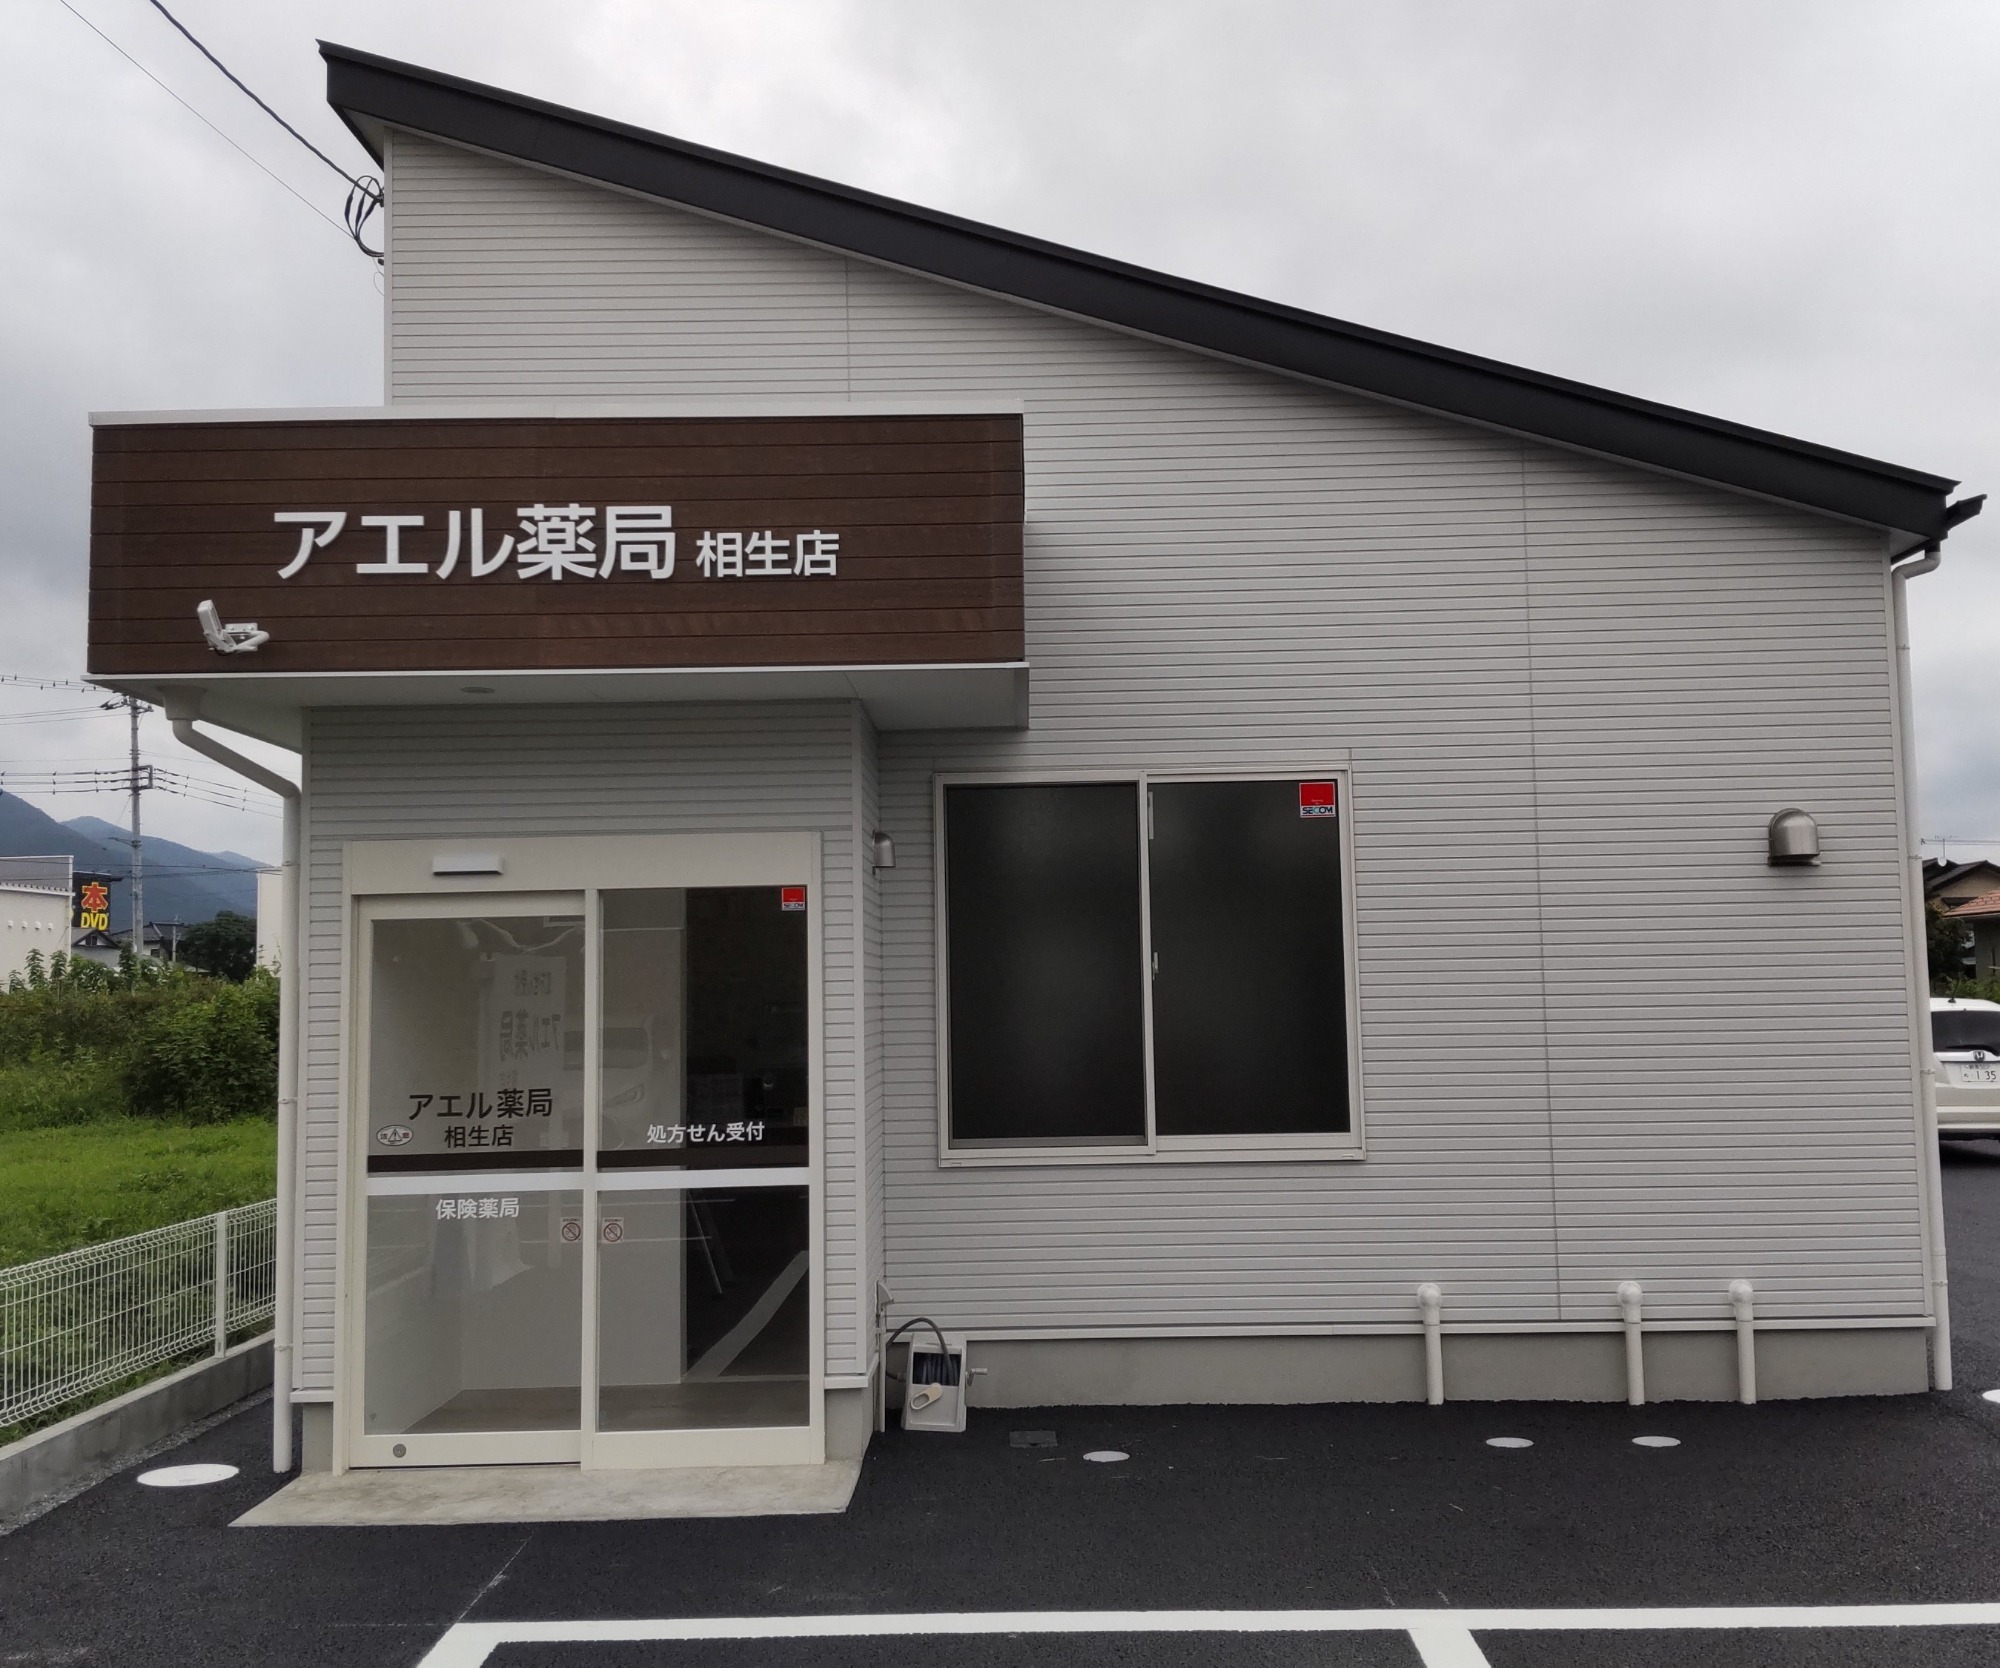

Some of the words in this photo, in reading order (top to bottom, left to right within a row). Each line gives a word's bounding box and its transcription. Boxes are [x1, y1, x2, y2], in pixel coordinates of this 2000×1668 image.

[274, 503, 676, 581] アエル薬局
[695, 529, 840, 578] 相生店
[1302, 806, 1333, 814] SECOM
[81, 882, 108, 913] 本
[81, 912, 109, 931] DVD
[408, 1088, 553, 1121] アエル薬局
[444, 1124, 514, 1148] 相生店
[647, 1121, 765, 1143] 処方せん受付
[435, 1197, 520, 1220] 保険薬局
